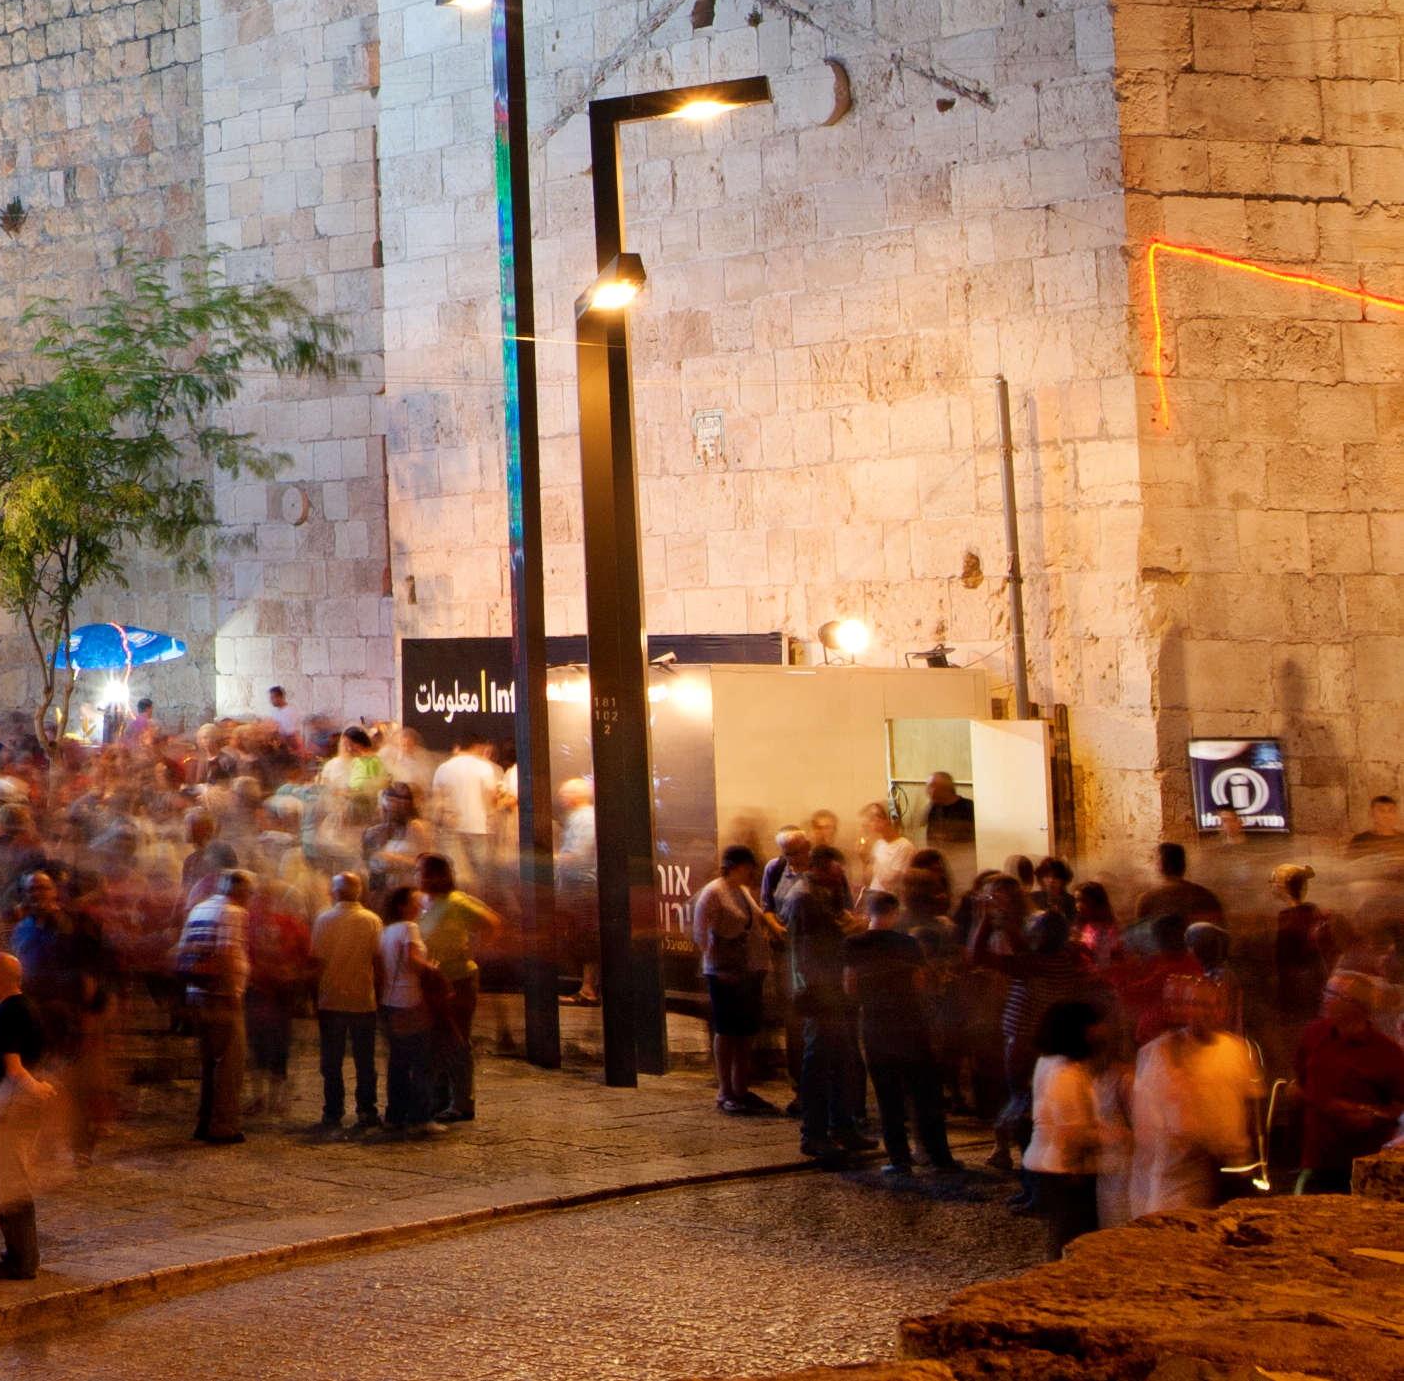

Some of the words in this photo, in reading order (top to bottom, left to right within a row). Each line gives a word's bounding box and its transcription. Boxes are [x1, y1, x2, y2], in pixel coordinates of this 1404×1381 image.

[415, 680, 479, 723] معلومات
[490, 680, 516, 713] Inf
[594, 697, 616, 708] 181
[595, 710, 618, 722] 102
[604, 724, 611, 735] 2
